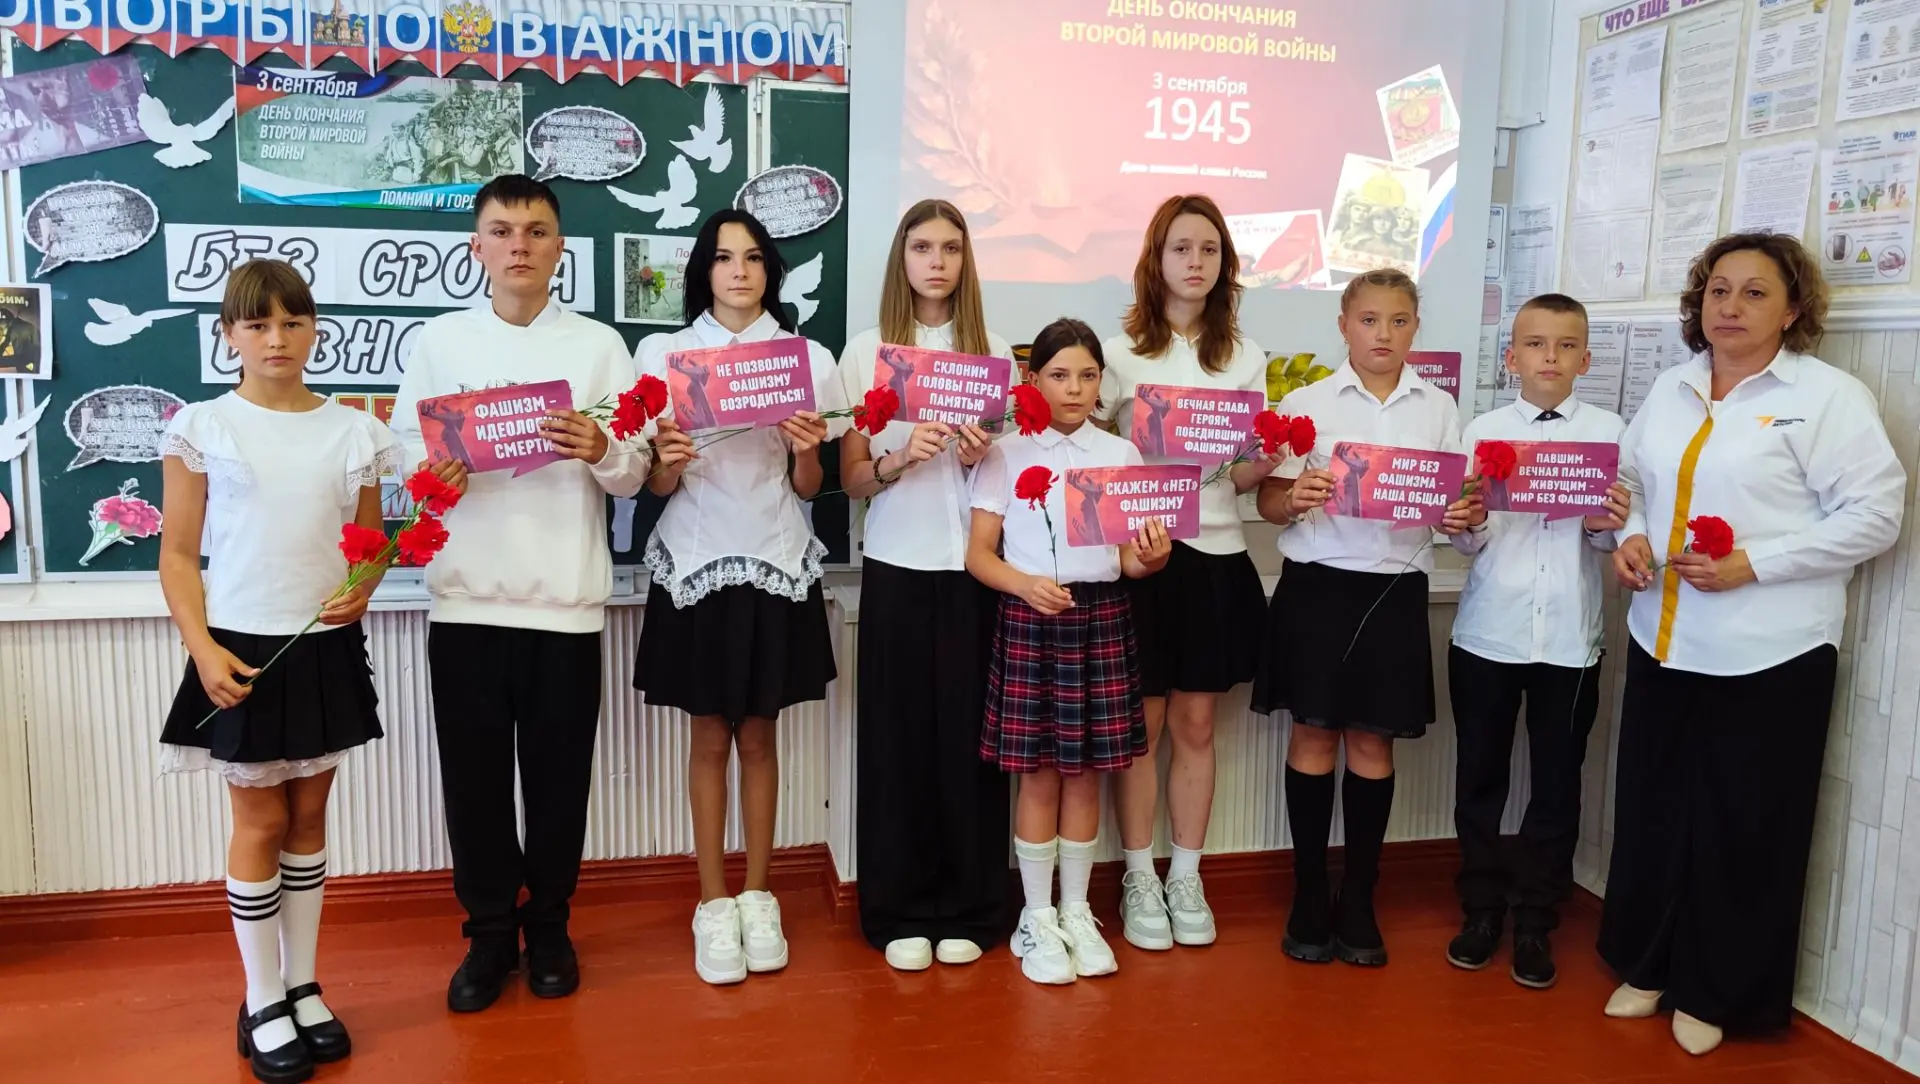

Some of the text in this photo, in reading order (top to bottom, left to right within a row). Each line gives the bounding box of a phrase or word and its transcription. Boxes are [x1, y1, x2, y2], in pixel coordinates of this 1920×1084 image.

[1107, 0, 1297, 28] ДЕНЬ ОКОНЧАНИЯ
[1604, 8, 1635, 32] ЧТО
[385, 4, 430, 52] О
[512, 12, 843, 66] ВАЖНОМ
[1060, 21, 1337, 63] ВТОРОЙ МИРОВОЙ ВОЙНЫ
[256, 70, 358, 99] 3 сентября
[1152, 72, 1248, 97] 3 сентября
[258, 104, 365, 123] ДЕНЬ ОКОНЧАНИЯ
[1144, 96, 1252, 145] 1945
[259, 123, 367, 144] ВТОРОЙ МИРОВОЙ
[260, 142, 305, 160] ВОЙНЫ
[380, 190, 434, 207] ПОМНИМ
[435, 193, 444, 208] И
[717, 355, 799, 378] НЕ ПОЗВОЛИМ
[933, 360, 989, 379] СКЛОНИМ
[729, 373, 791, 393] ФАШИЗМУ
[916, 375, 1002, 400] ГОЛОВЫ ПЕРЕД
[475, 395, 547, 418] ФАШИЗМ
[720, 388, 806, 412] ВОЗРОДИТЬСЯ!
[929, 393, 985, 412] ПАМЯТЬЮ
[1177, 398, 1250, 414] ВЕЧНАЯ СЛАВА
[918, 407, 981, 426] ПОГИБШИХ
[1191, 413, 1233, 428] ГЕРОЯМ,
[1175, 426, 1246, 442] ПОБЕДИВШИМ
[494, 438, 554, 459] СМЕРТИ
[1184, 441, 1234, 455] ФАШИЗМ!
[1392, 457, 1440, 474] МИР БЕЗ
[1536, 453, 1584, 465] ПАВШИМ
[1378, 472, 1436, 489] ФАШИЗМА
[1519, 466, 1607, 480] ВЕЧНАЯ ПАМЯТЬ,
[1106, 479, 1198, 496] СКАЖЕМ «НЕТ»
[1529, 480, 1587, 492] ЖИВУЩИМ
[1120, 496, 1184, 513] ФАШИЗМУ
[1373, 488, 1447, 506] НАША ОБЩАЯ
[1511, 492, 1534, 503] МИР
[1537, 492, 1556, 504] БЕЗ
[1128, 514, 1177, 531] ВМТЕ!
[1393, 506, 1422, 520] ЦЕЛЬ
